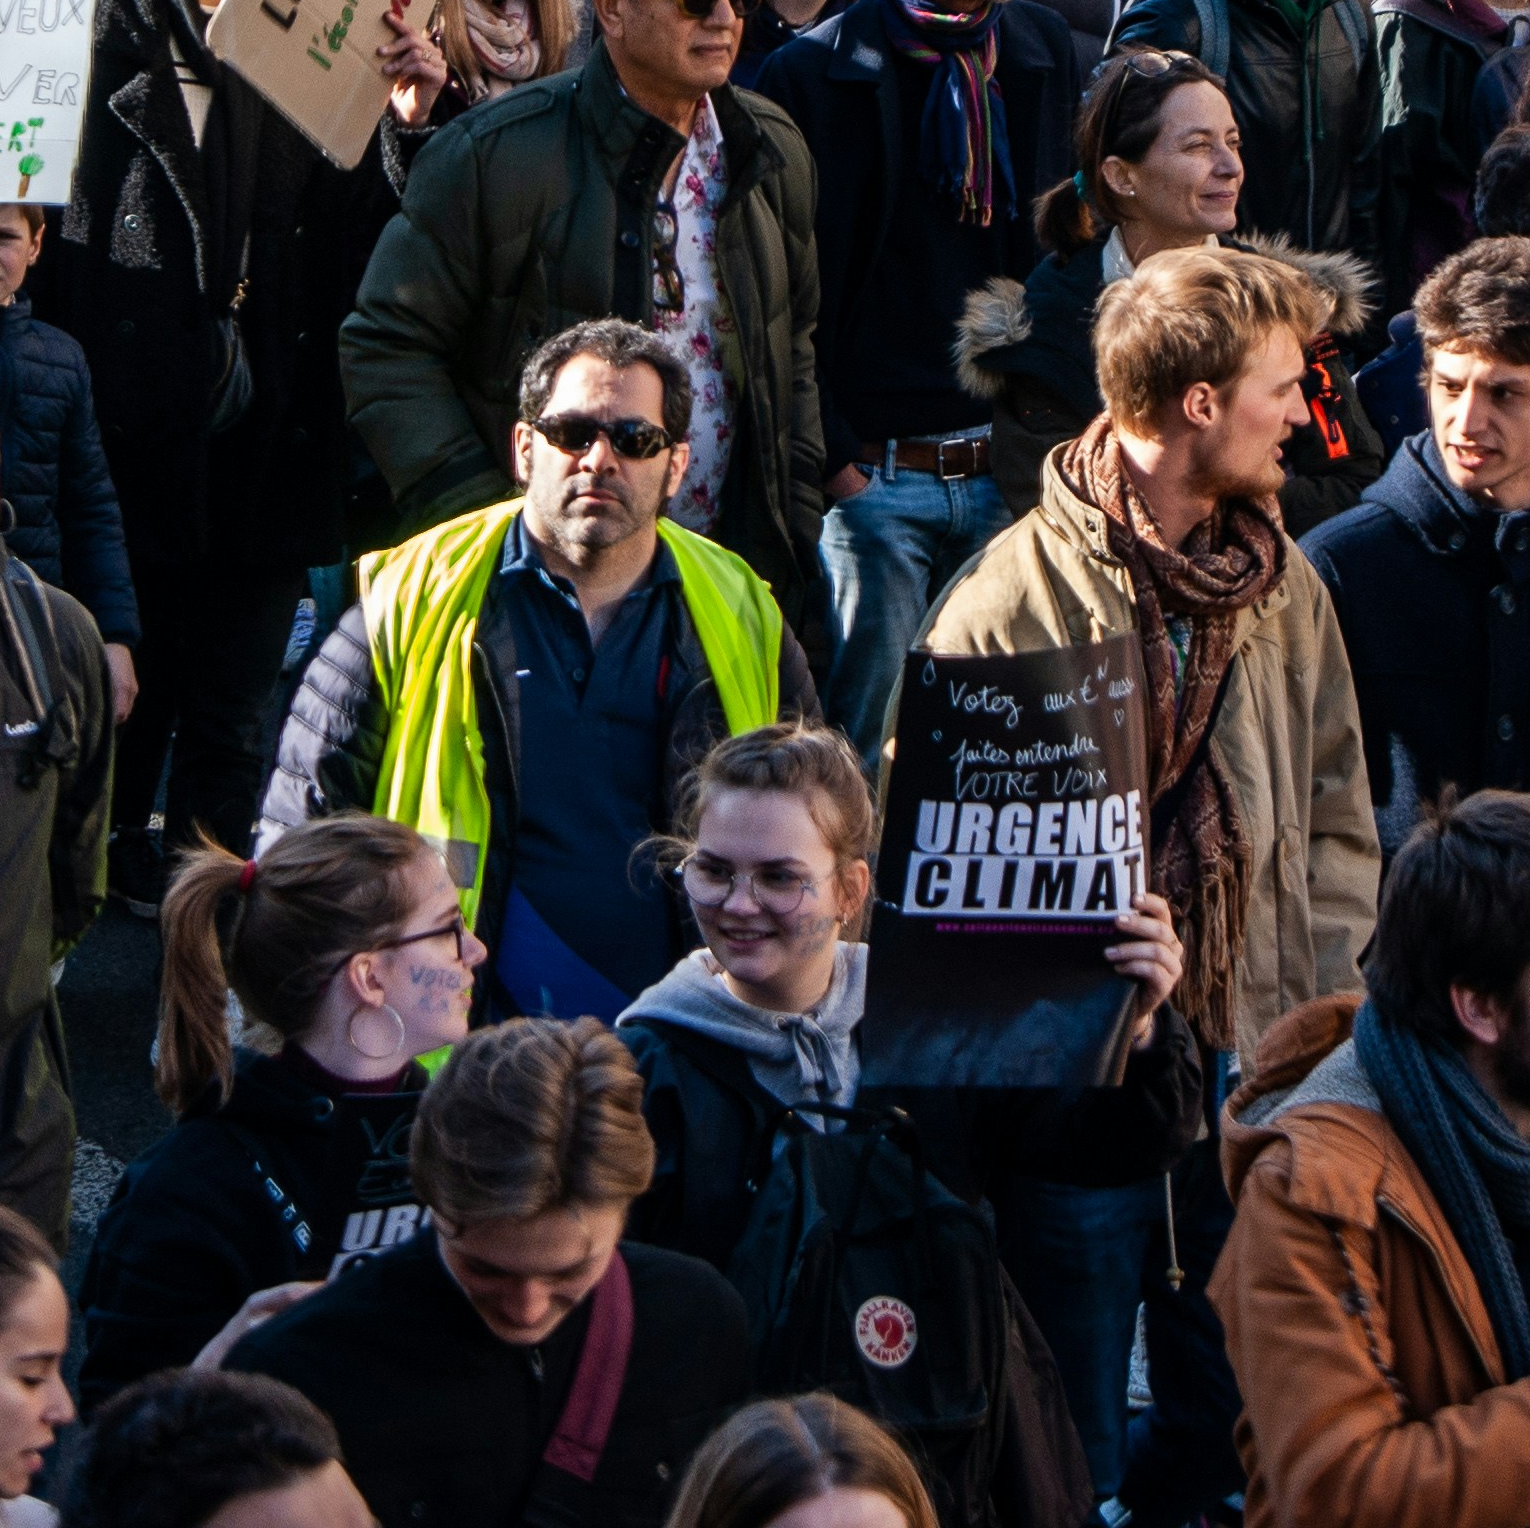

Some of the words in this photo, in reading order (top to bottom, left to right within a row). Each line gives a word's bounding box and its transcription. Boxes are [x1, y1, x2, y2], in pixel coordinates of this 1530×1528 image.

[950, 679, 1024, 729] Votez
[914, 789, 1146, 856] URGENCE
[912, 852, 1146, 911] CLIMAT
